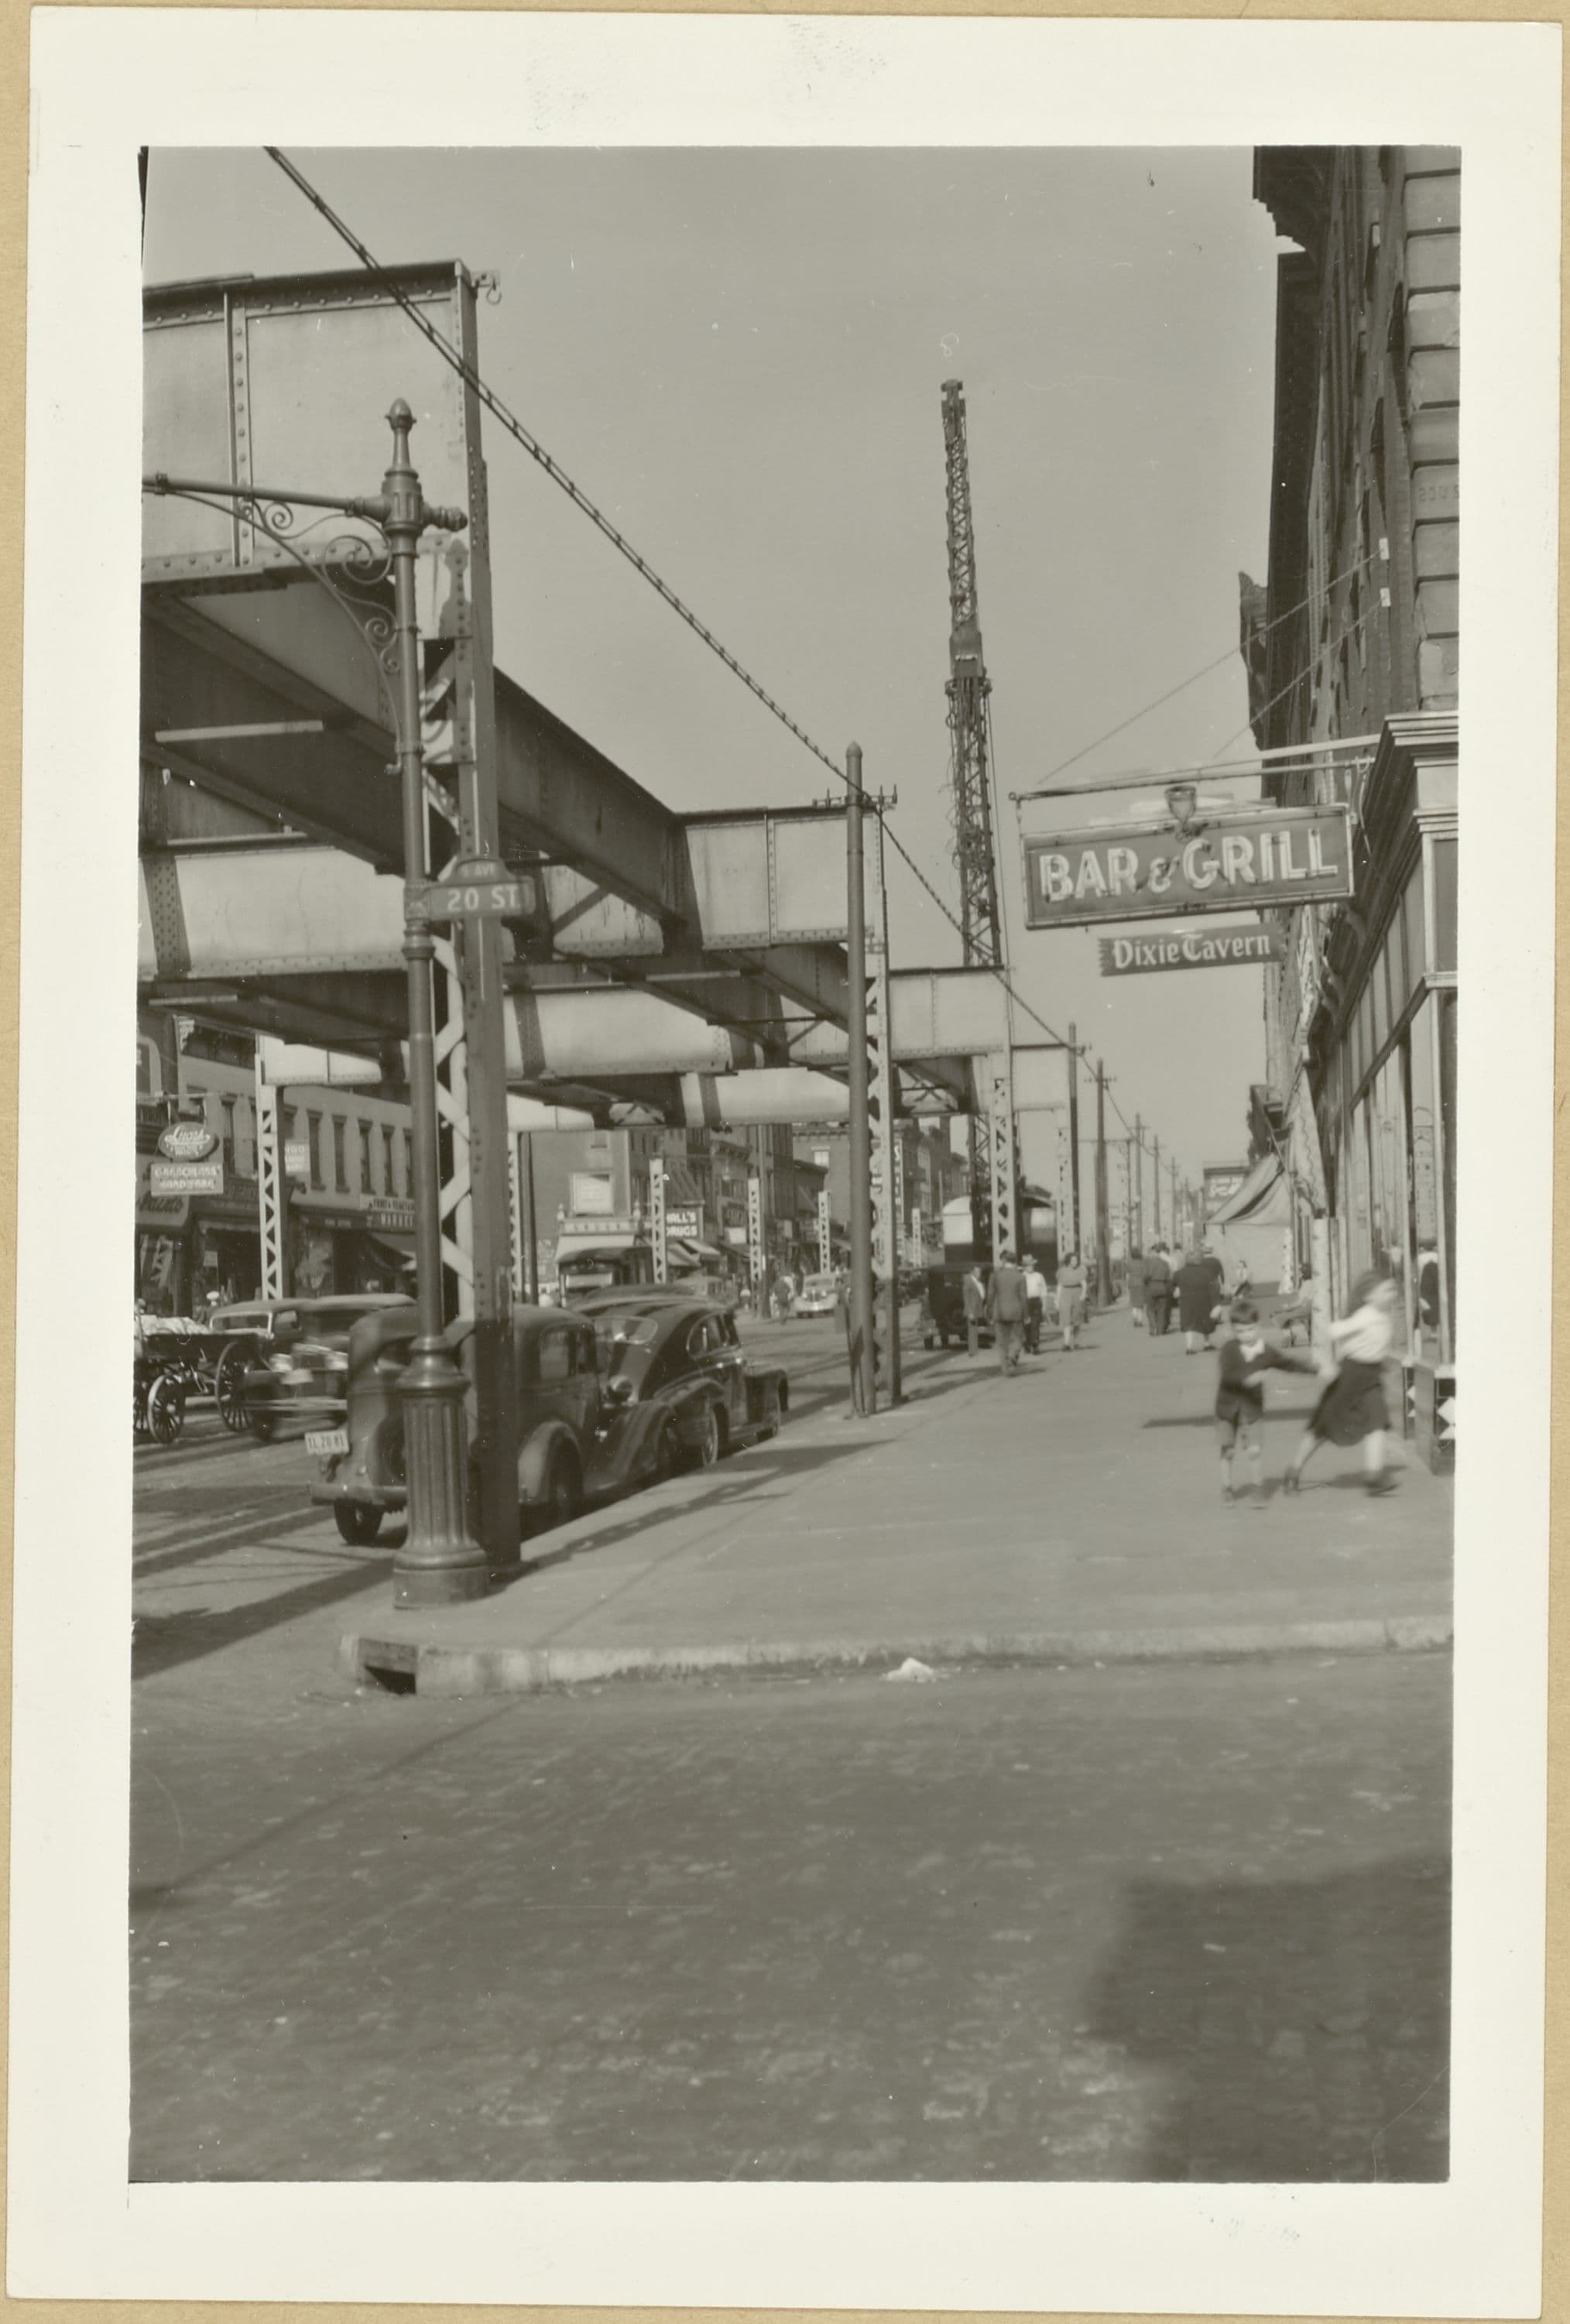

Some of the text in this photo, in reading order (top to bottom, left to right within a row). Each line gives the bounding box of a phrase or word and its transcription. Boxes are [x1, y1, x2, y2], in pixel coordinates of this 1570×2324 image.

[1040, 830, 1339, 903] BAR & GRILL
[447, 883, 521, 912] 20 ST
[1112, 931, 1271, 969] Dixie Tavern
